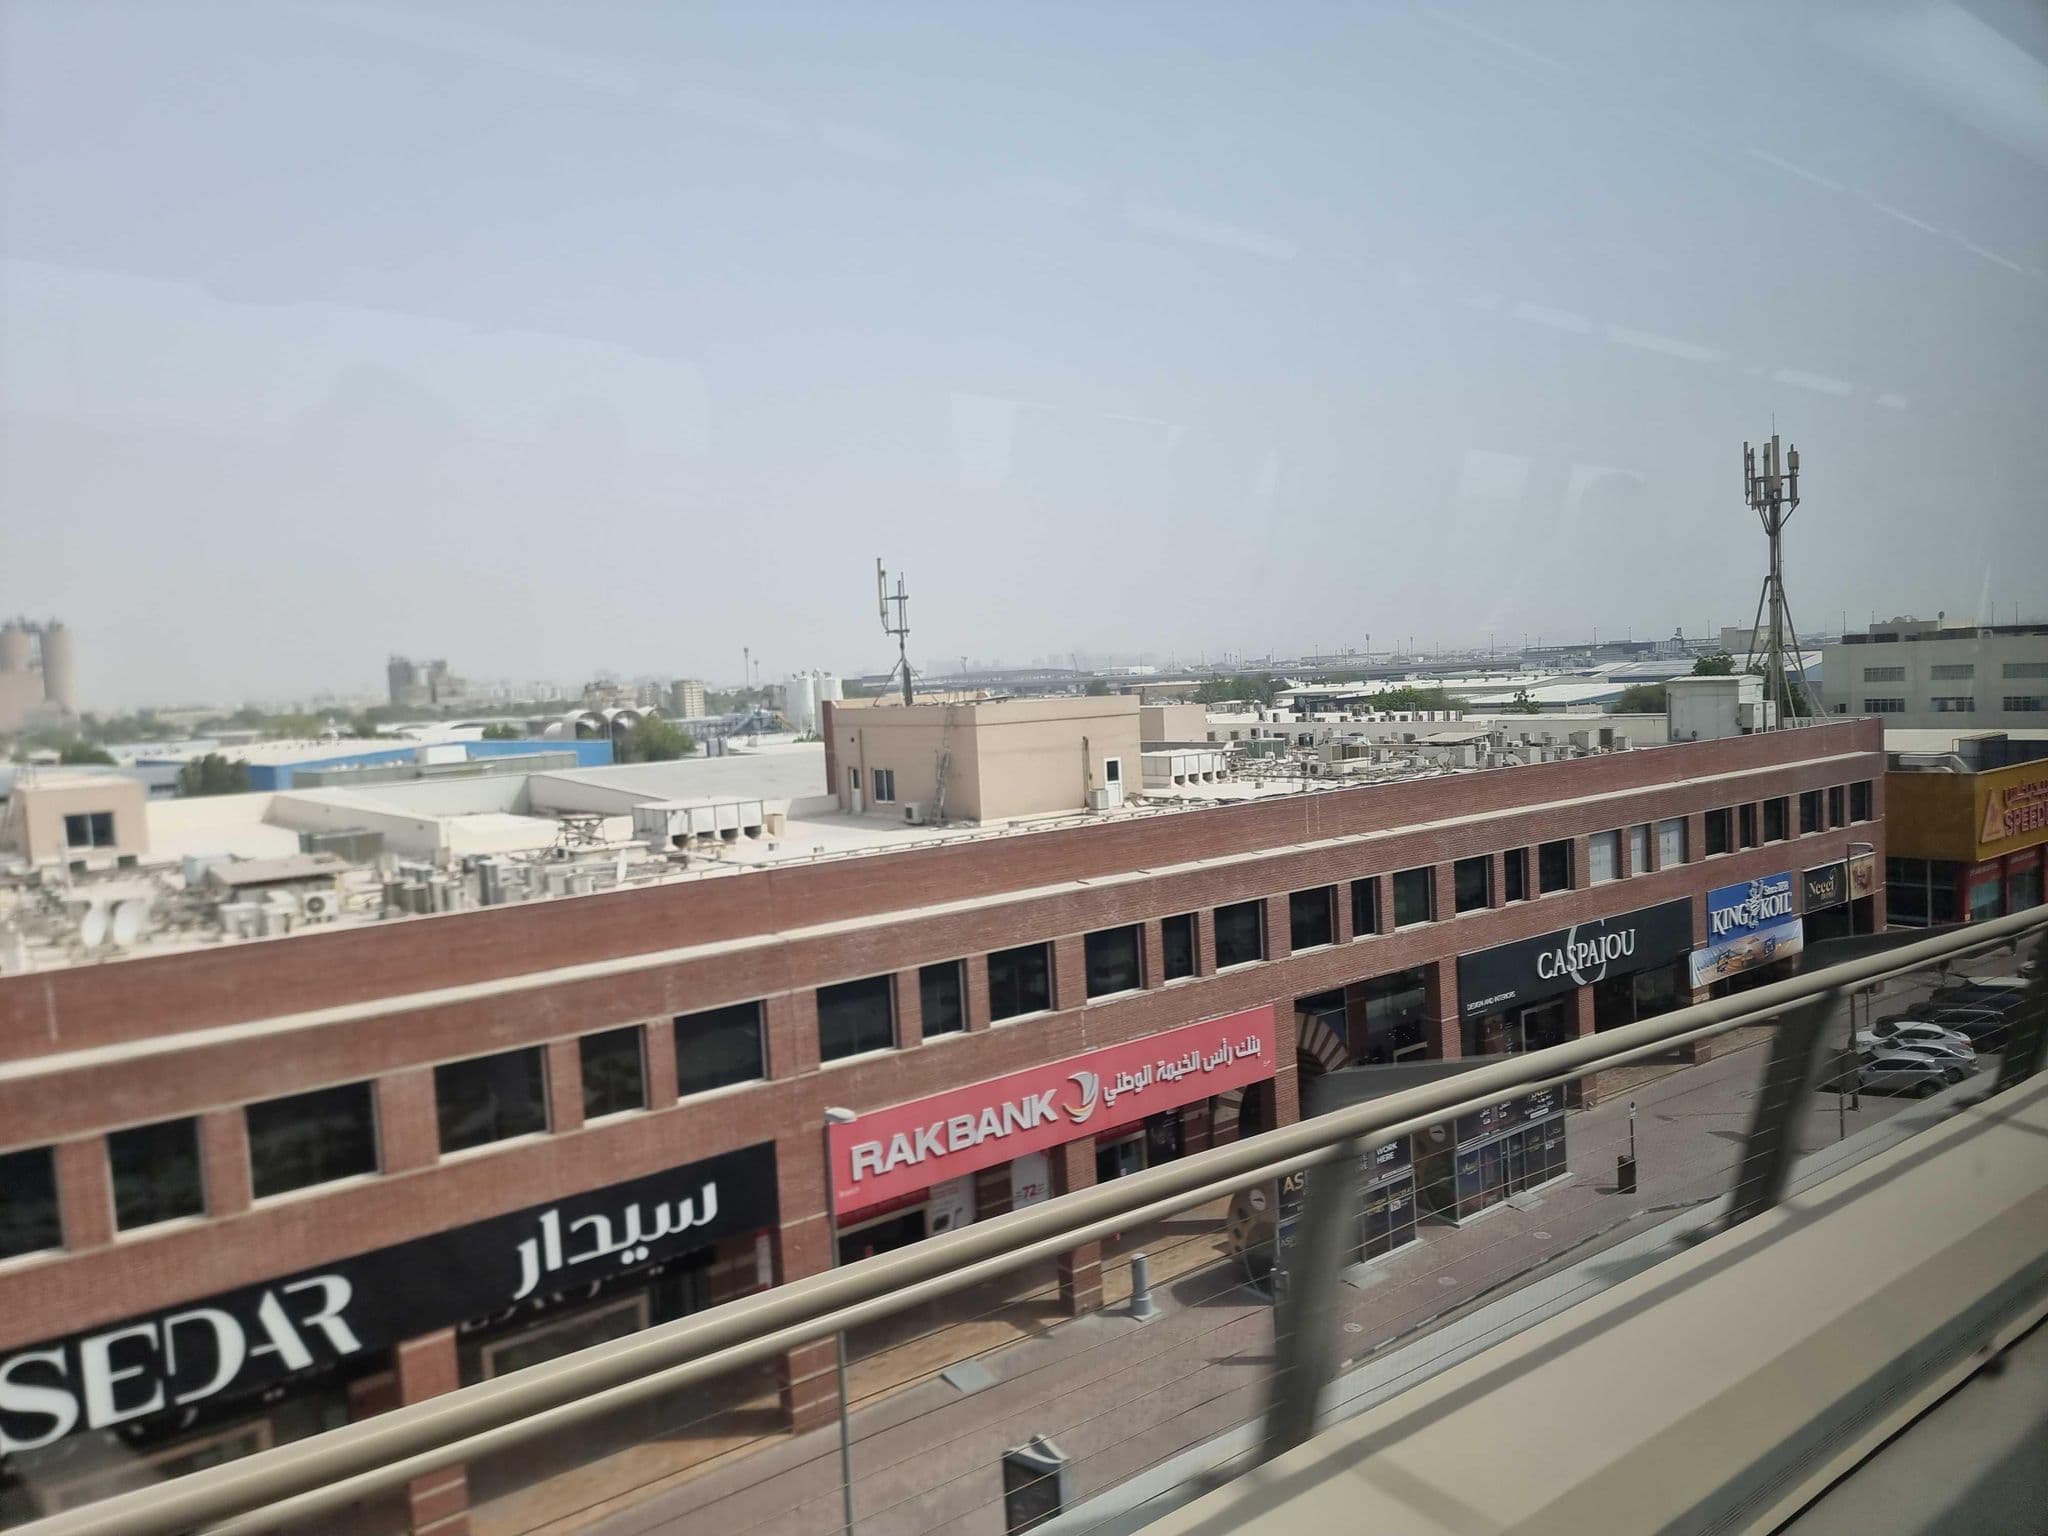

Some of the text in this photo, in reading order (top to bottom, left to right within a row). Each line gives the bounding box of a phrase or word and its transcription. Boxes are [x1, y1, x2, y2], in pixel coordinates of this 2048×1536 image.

[2004, 801, 2048, 836] SPEED
[1711, 892, 1792, 935] KING KOIL
[1103, 1035, 1262, 1106] بنك رأس الخيمة الوطني
[850, 1088, 1059, 1182] RAKBANK
[513, 1181, 718, 1300] سيدار
[0, 1274, 363, 1453] SEDAR
